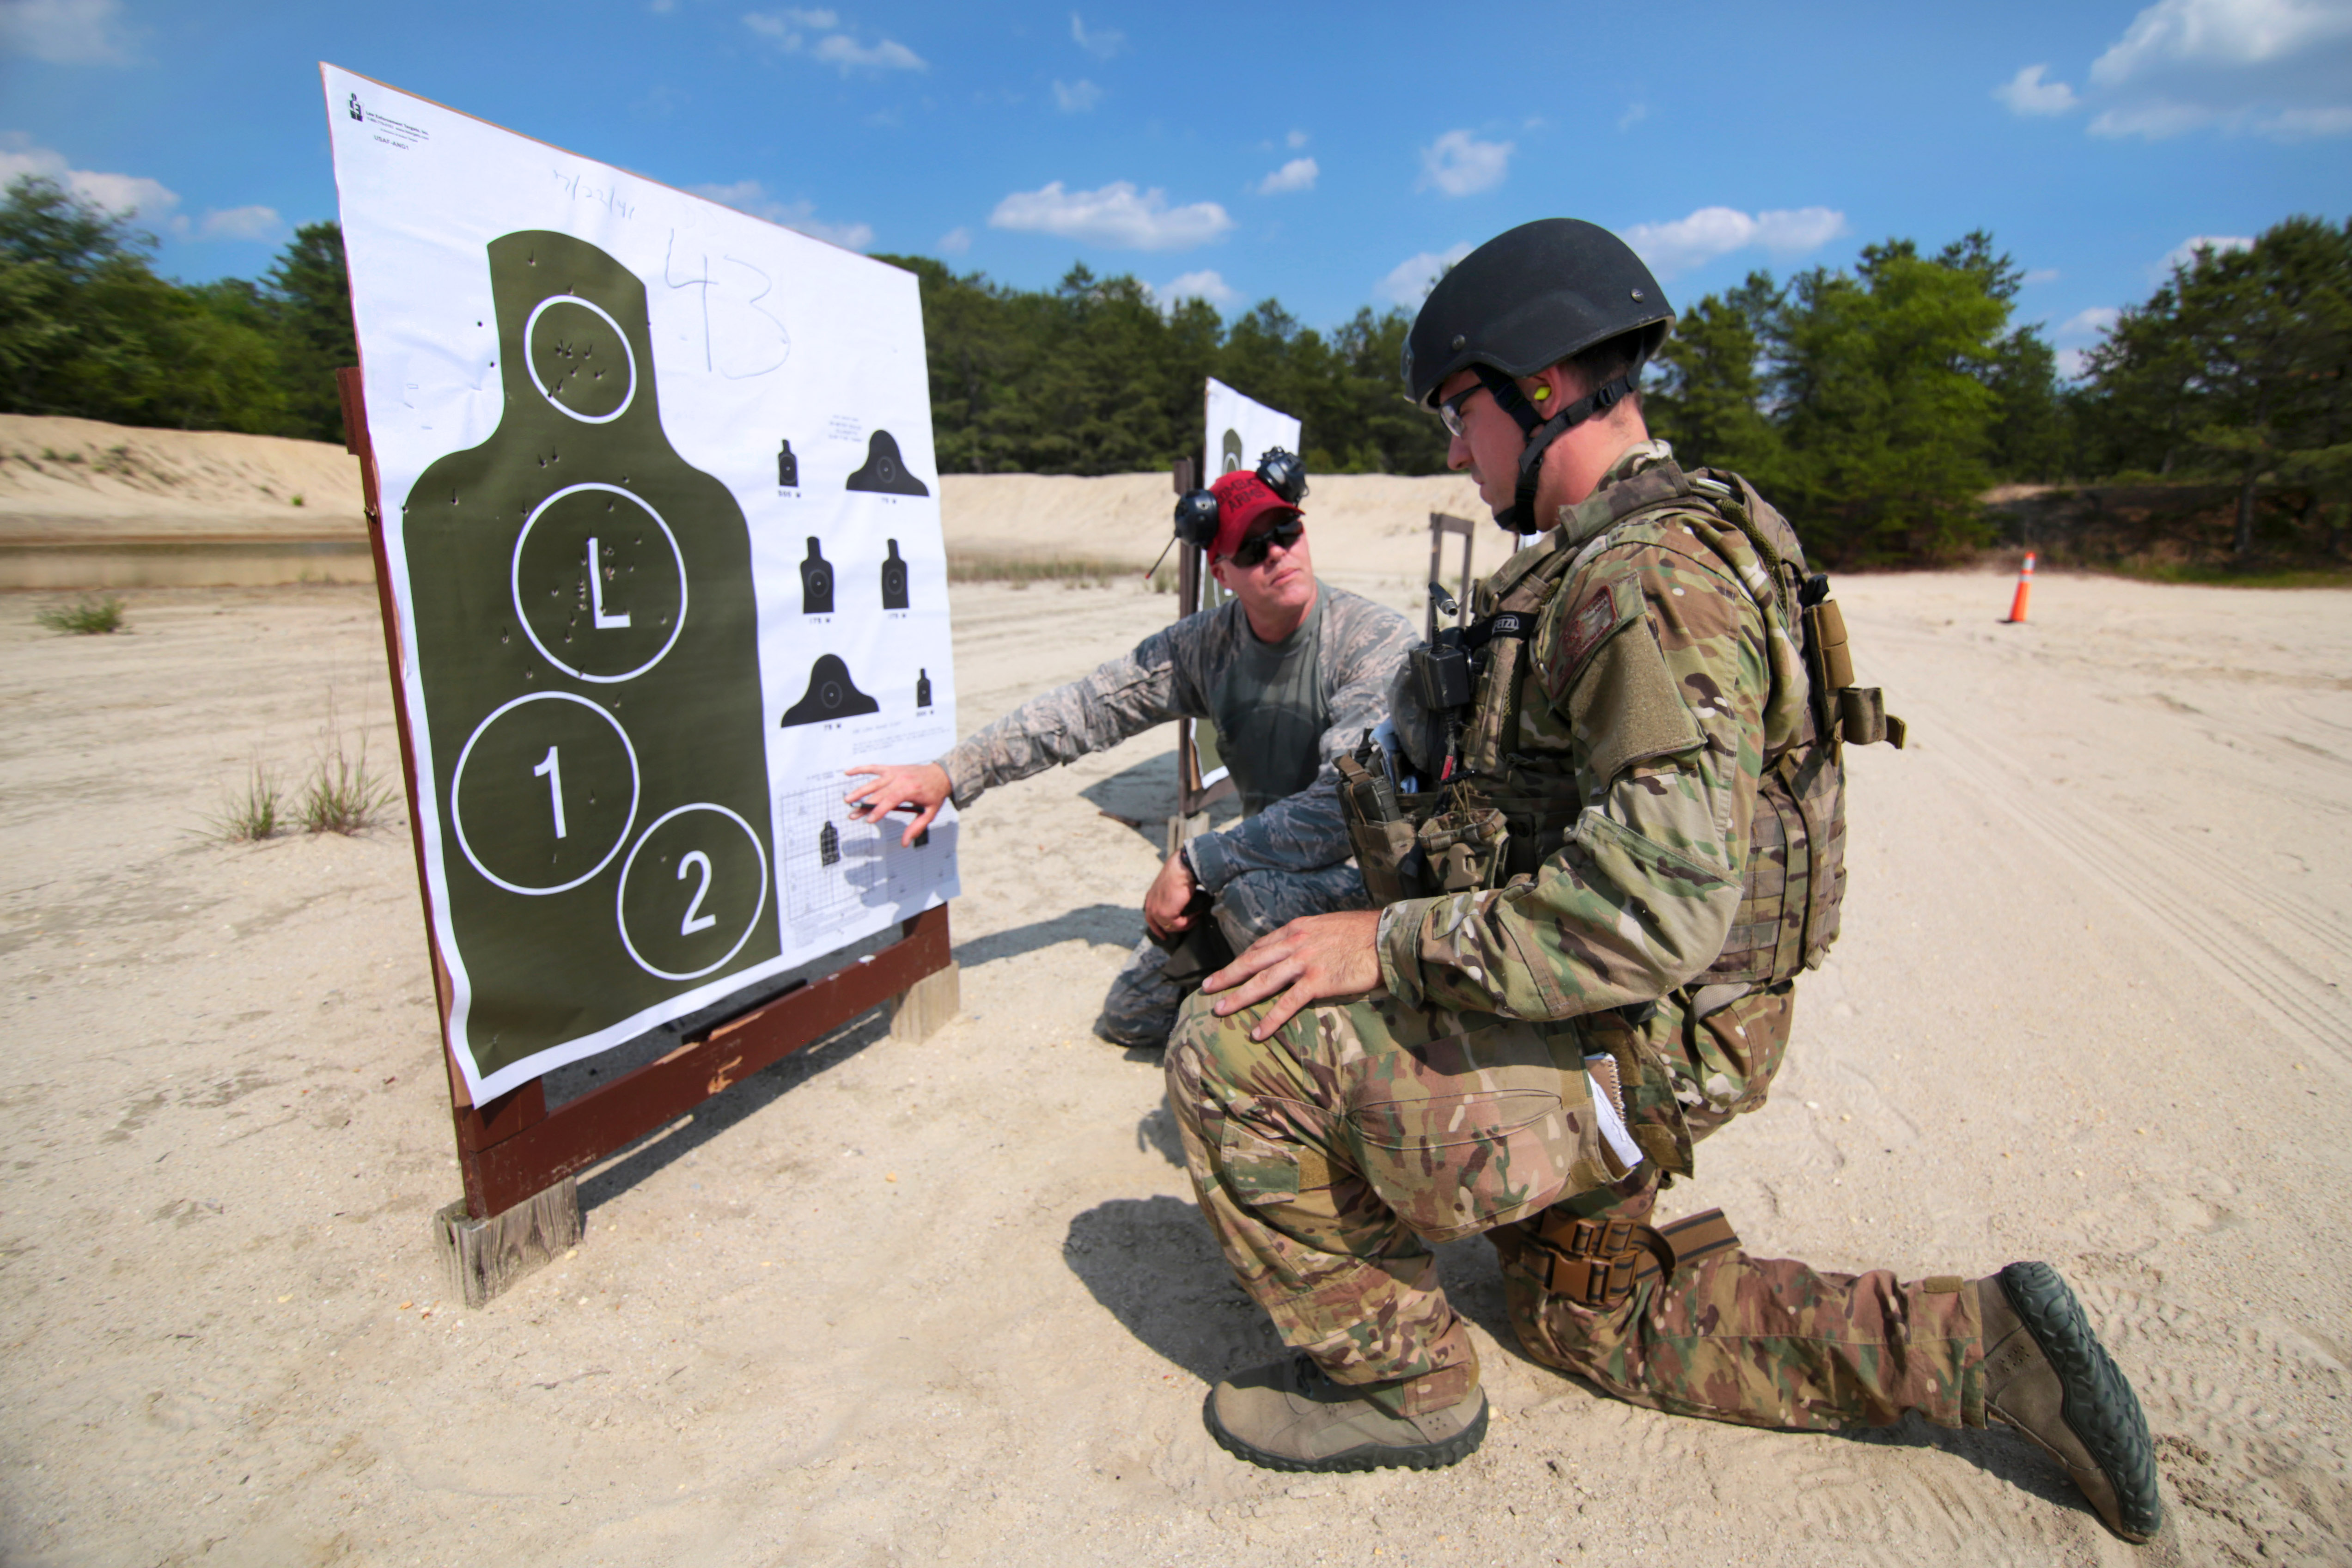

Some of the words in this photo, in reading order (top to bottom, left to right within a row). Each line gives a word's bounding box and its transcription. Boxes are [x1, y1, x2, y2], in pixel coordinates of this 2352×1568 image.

[1228, 490, 1266, 513] ARMS
[588, 537, 631, 629] L
[533, 746, 567, 839] 1
[677, 850, 717, 936] 2
